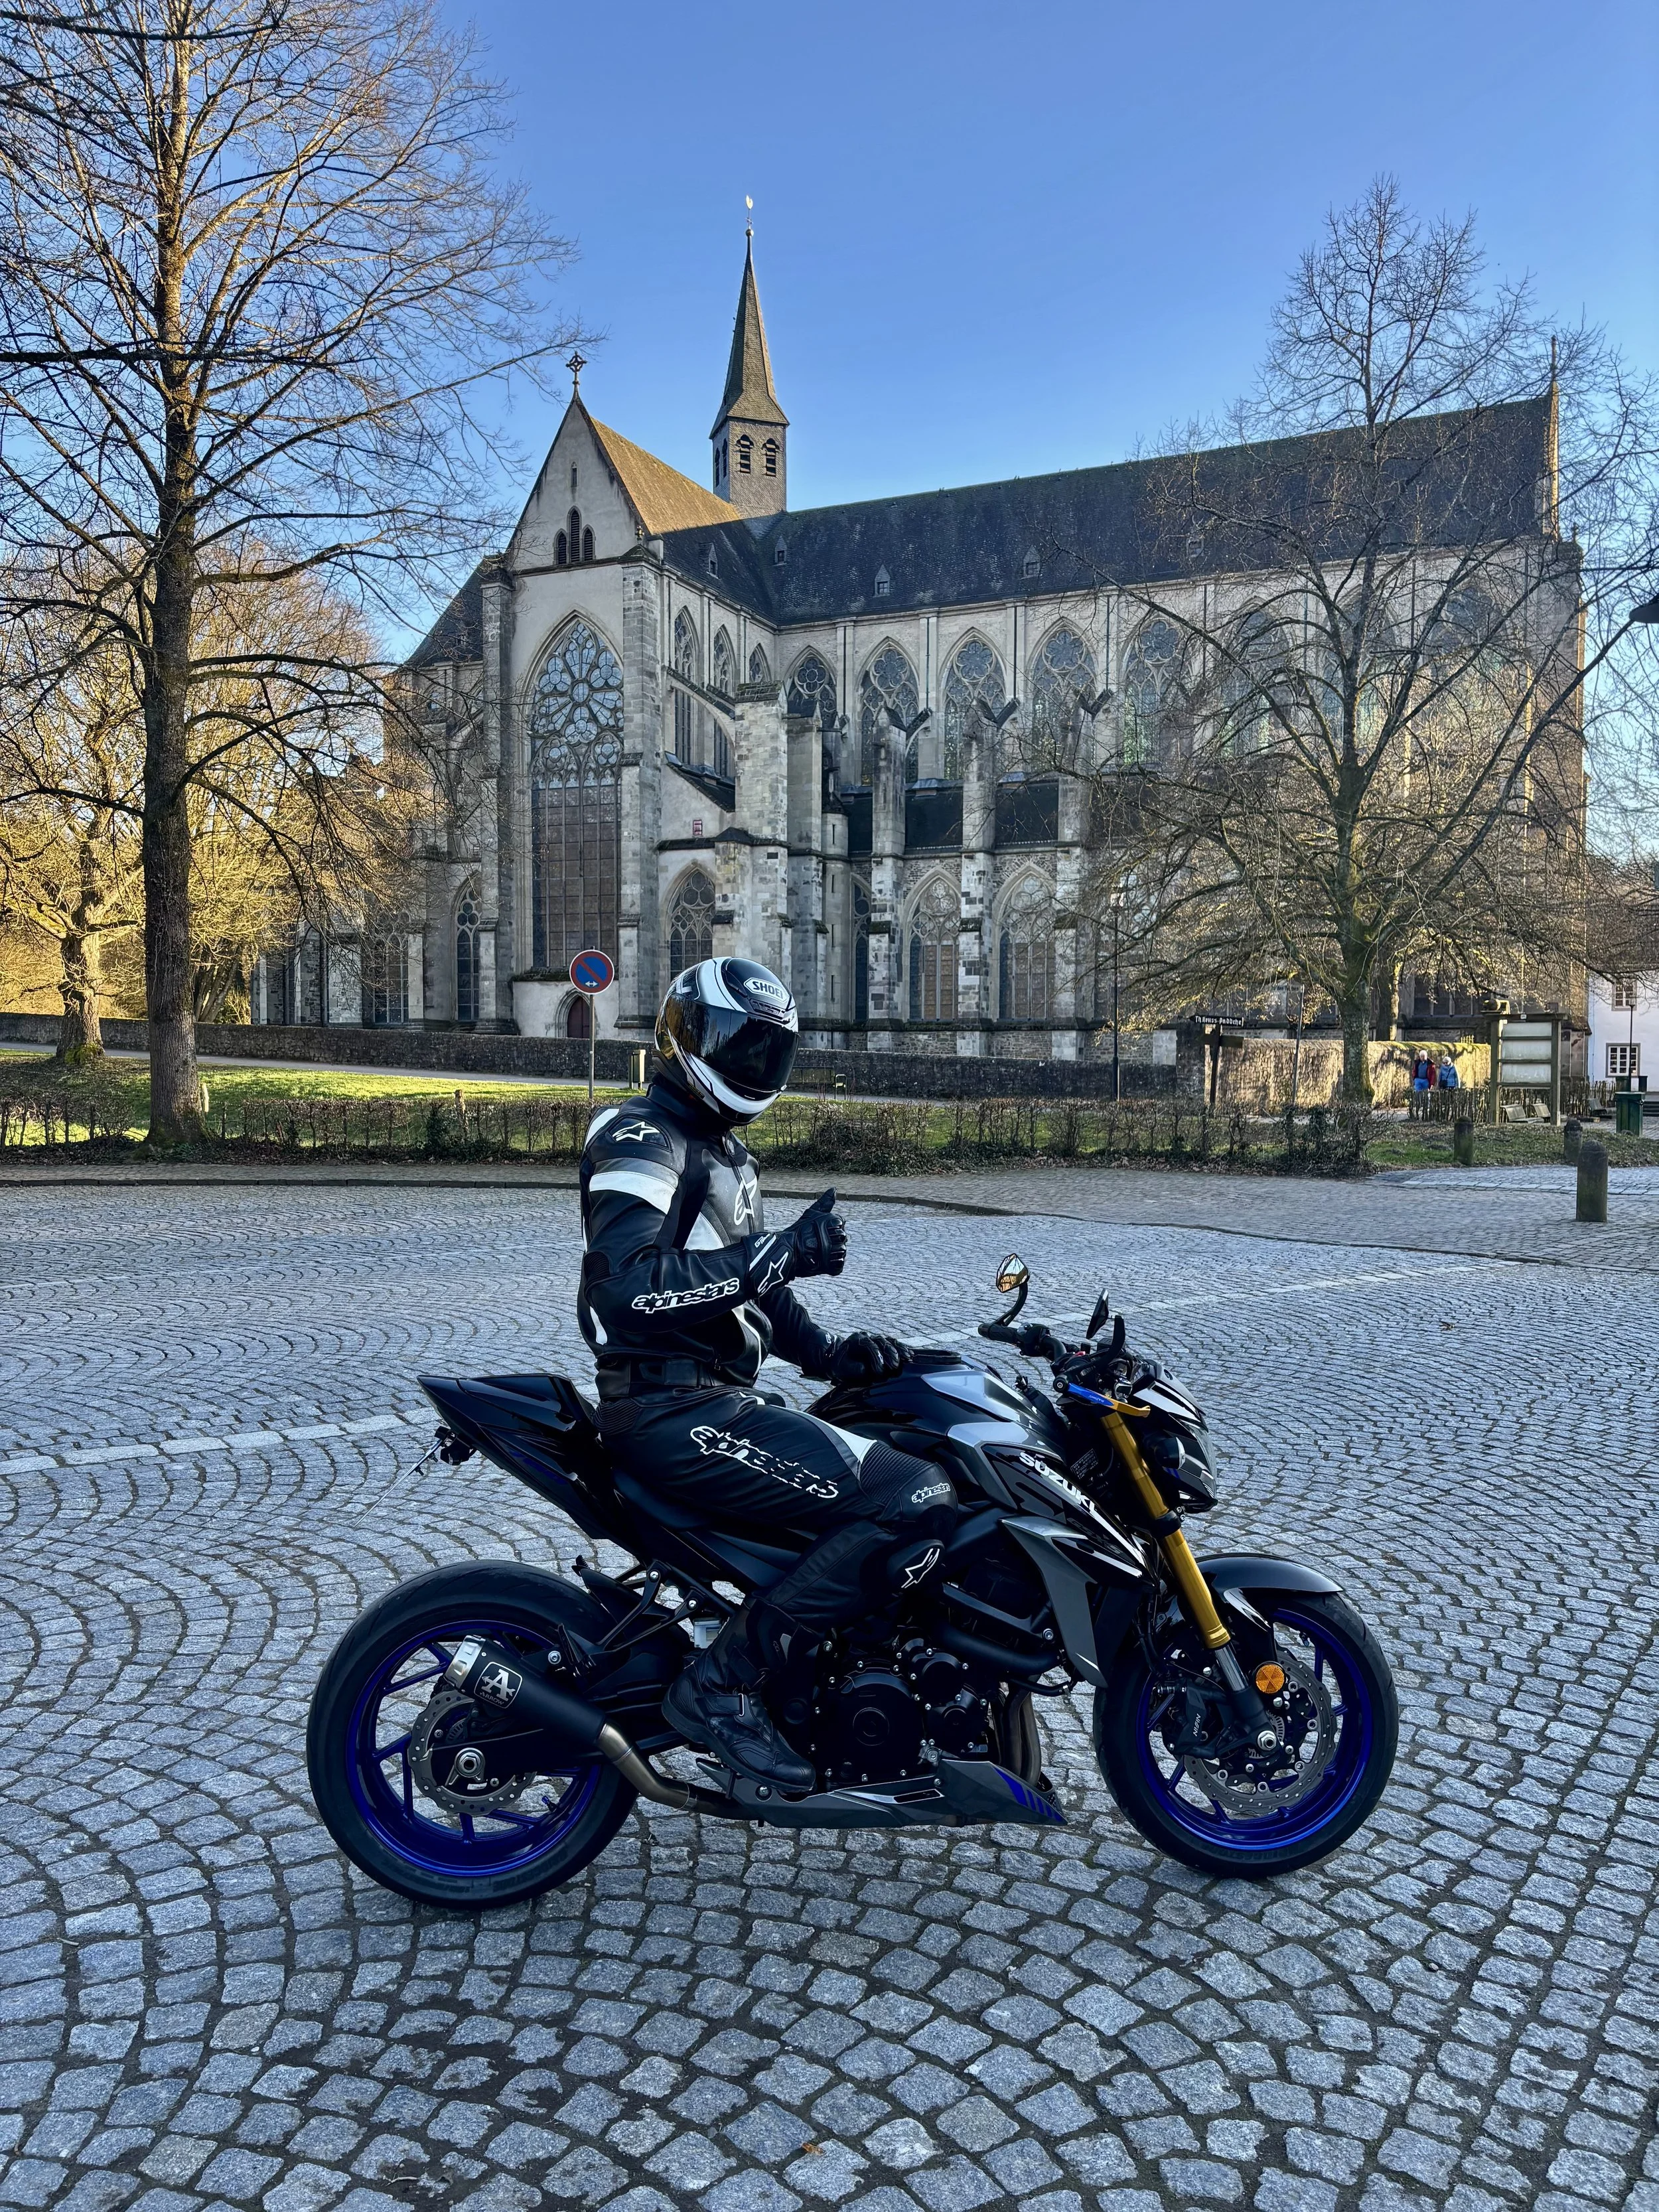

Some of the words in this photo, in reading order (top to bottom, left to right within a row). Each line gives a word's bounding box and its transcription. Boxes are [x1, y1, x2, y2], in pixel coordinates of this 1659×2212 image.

[752, 981, 784, 999] SHOEI
[632, 1278, 740, 1313] alpinestars
[1019, 1451, 1097, 1513] SUZUKI
[911, 1483, 951, 1503] alpinestars
[480, 1691, 504, 1705] ARROW
